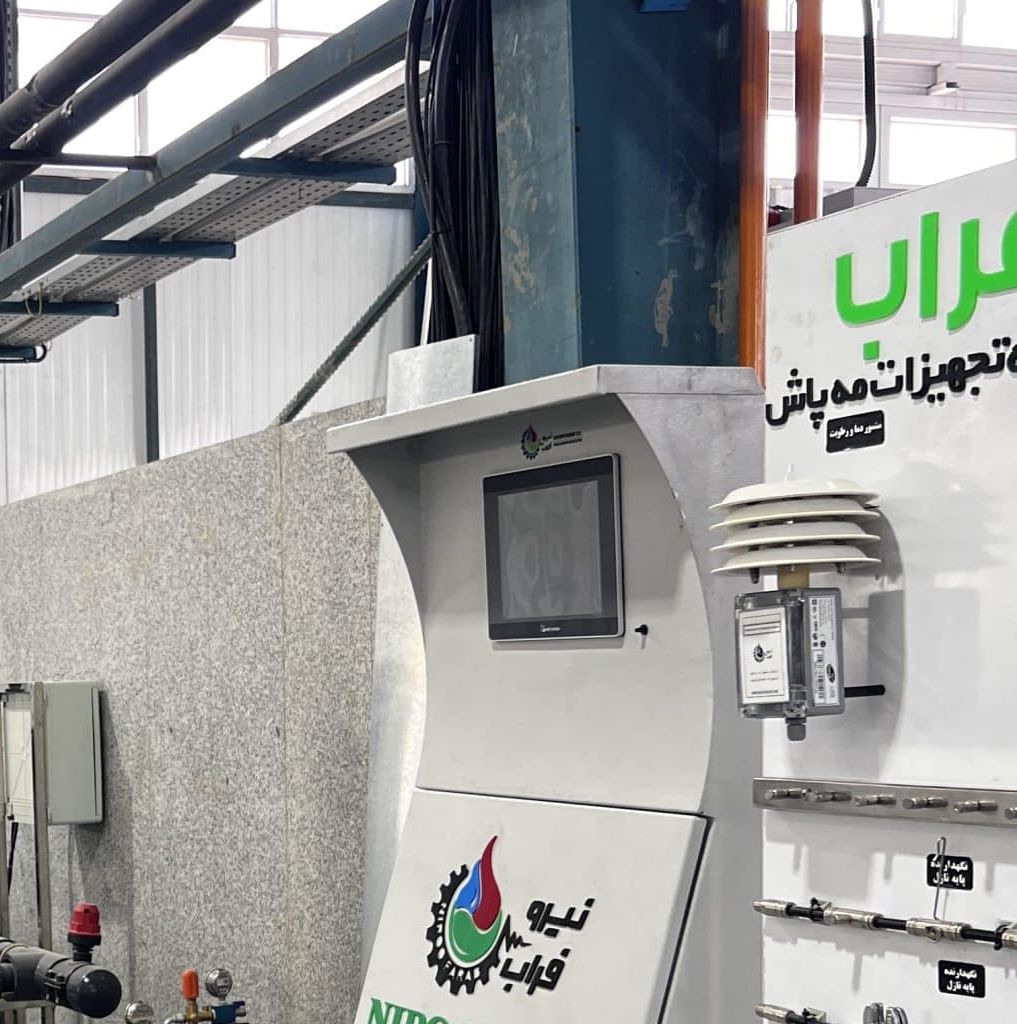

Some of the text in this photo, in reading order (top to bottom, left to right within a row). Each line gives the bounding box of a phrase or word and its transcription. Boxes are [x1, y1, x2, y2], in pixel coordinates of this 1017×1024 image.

[832, 379, 868, 404] مه
[870, 336, 1006, 403] تجهیزات
[766, 368, 828, 429] پاش
[526, 898, 596, 938] نیرو
[499, 948, 571, 995] فراب
